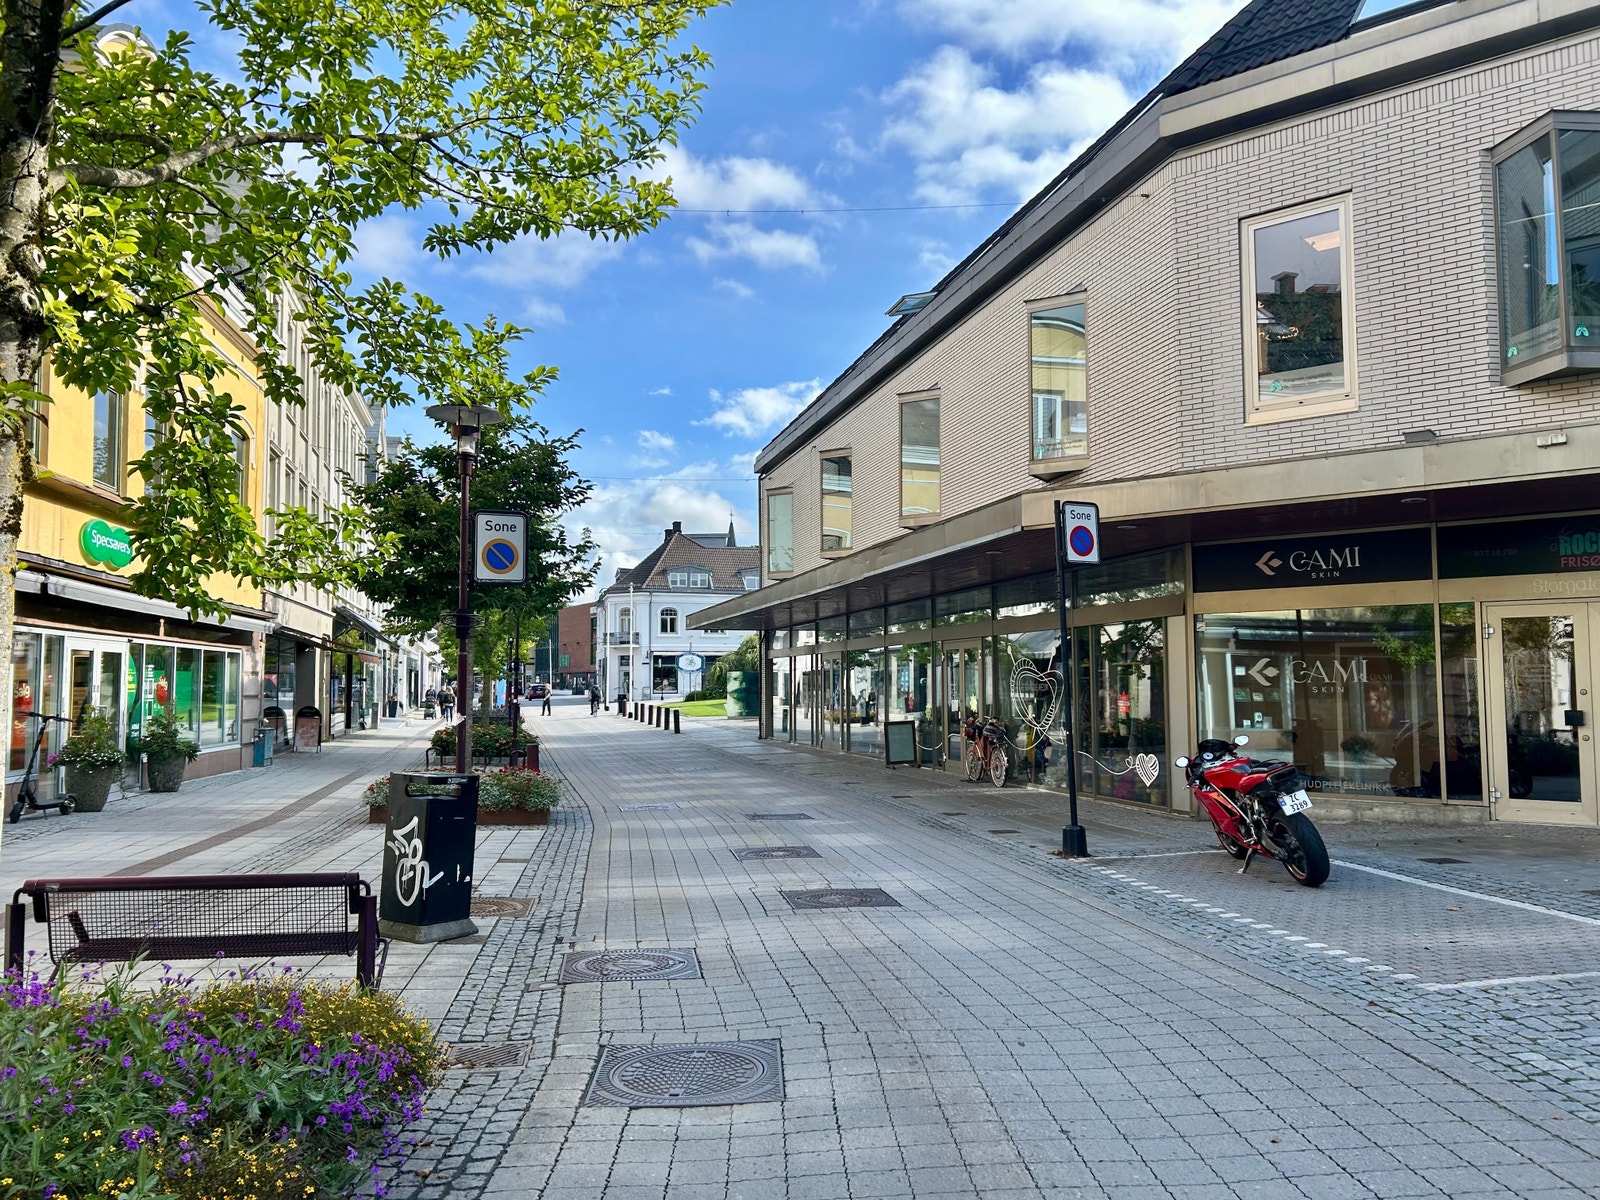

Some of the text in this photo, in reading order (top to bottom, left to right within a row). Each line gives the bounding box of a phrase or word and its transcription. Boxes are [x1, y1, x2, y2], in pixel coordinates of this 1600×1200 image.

[1070, 509, 1092, 521] Sone
[484, 519, 517, 532] Sone
[91, 529, 131, 555] Specsavers
[1559, 531, 1600, 556] ROC
[1289, 546, 1361, 572] CAMI
[1311, 571, 1341, 579] SKIN
[1287, 659, 1369, 684] CAMI
[1311, 686, 1345, 694] SKIN
[1288, 793, 1299, 803] ZC
[1290, 800, 1309, 813] 3289
